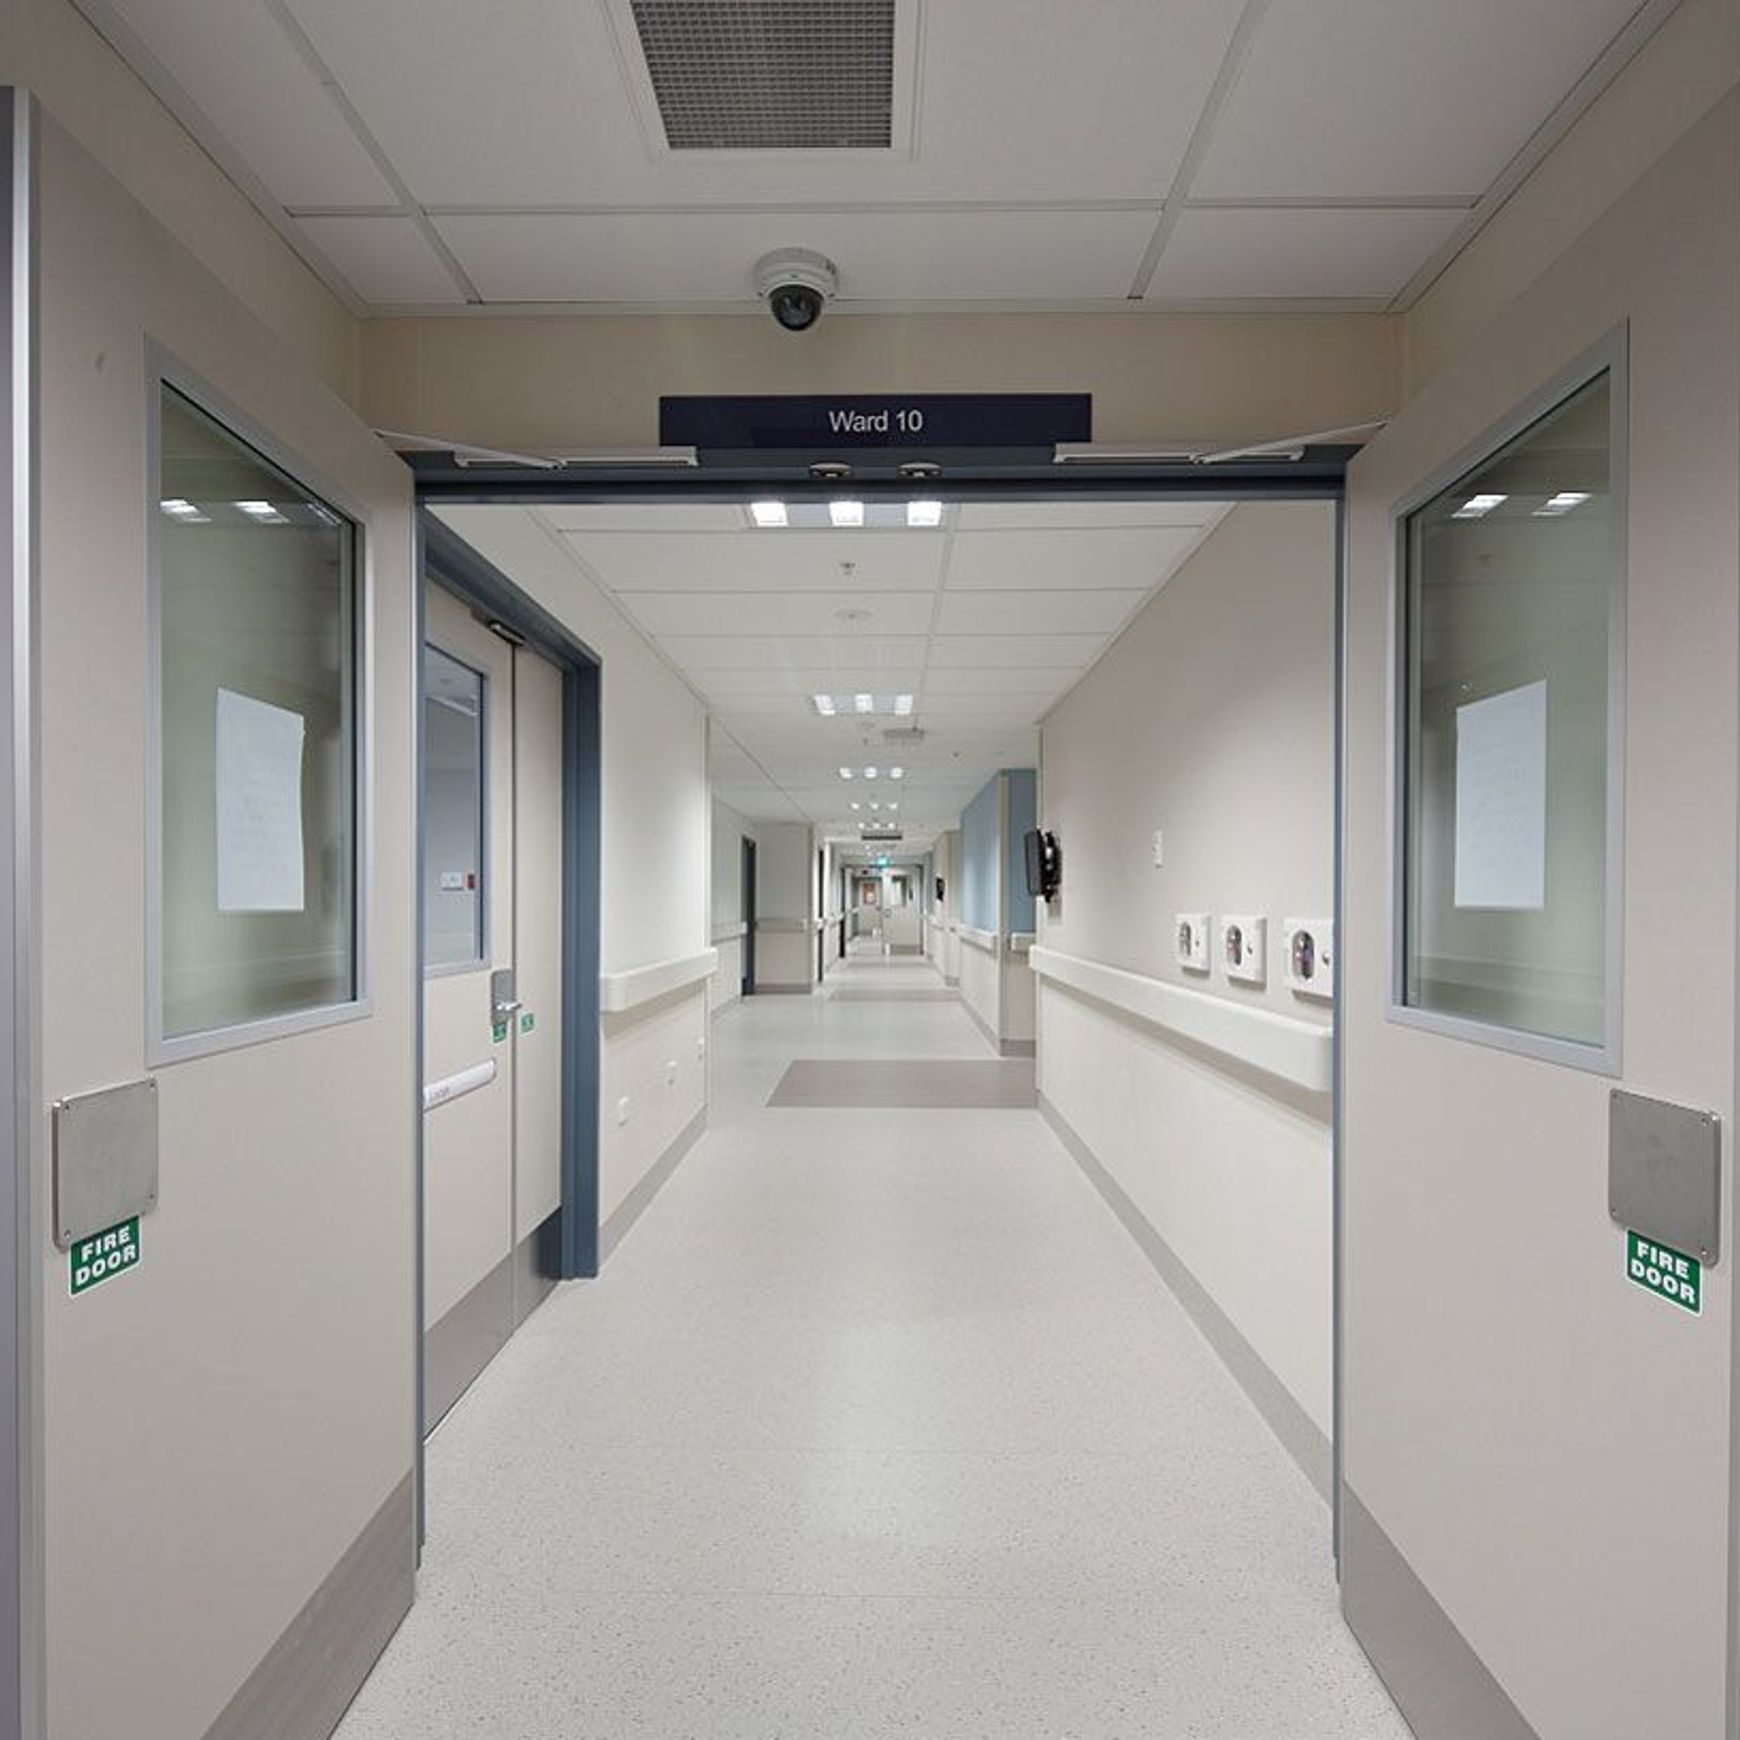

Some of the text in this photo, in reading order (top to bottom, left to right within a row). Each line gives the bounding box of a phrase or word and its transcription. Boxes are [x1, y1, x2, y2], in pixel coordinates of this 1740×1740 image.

[829, 409, 923, 432] Ward 10
[81, 1225, 130, 1263] FIRE
[1637, 1240, 1689, 1280] FIRE
[75, 1244, 136, 1286] DOOR
[1630, 1258, 1696, 1304] DOOR
